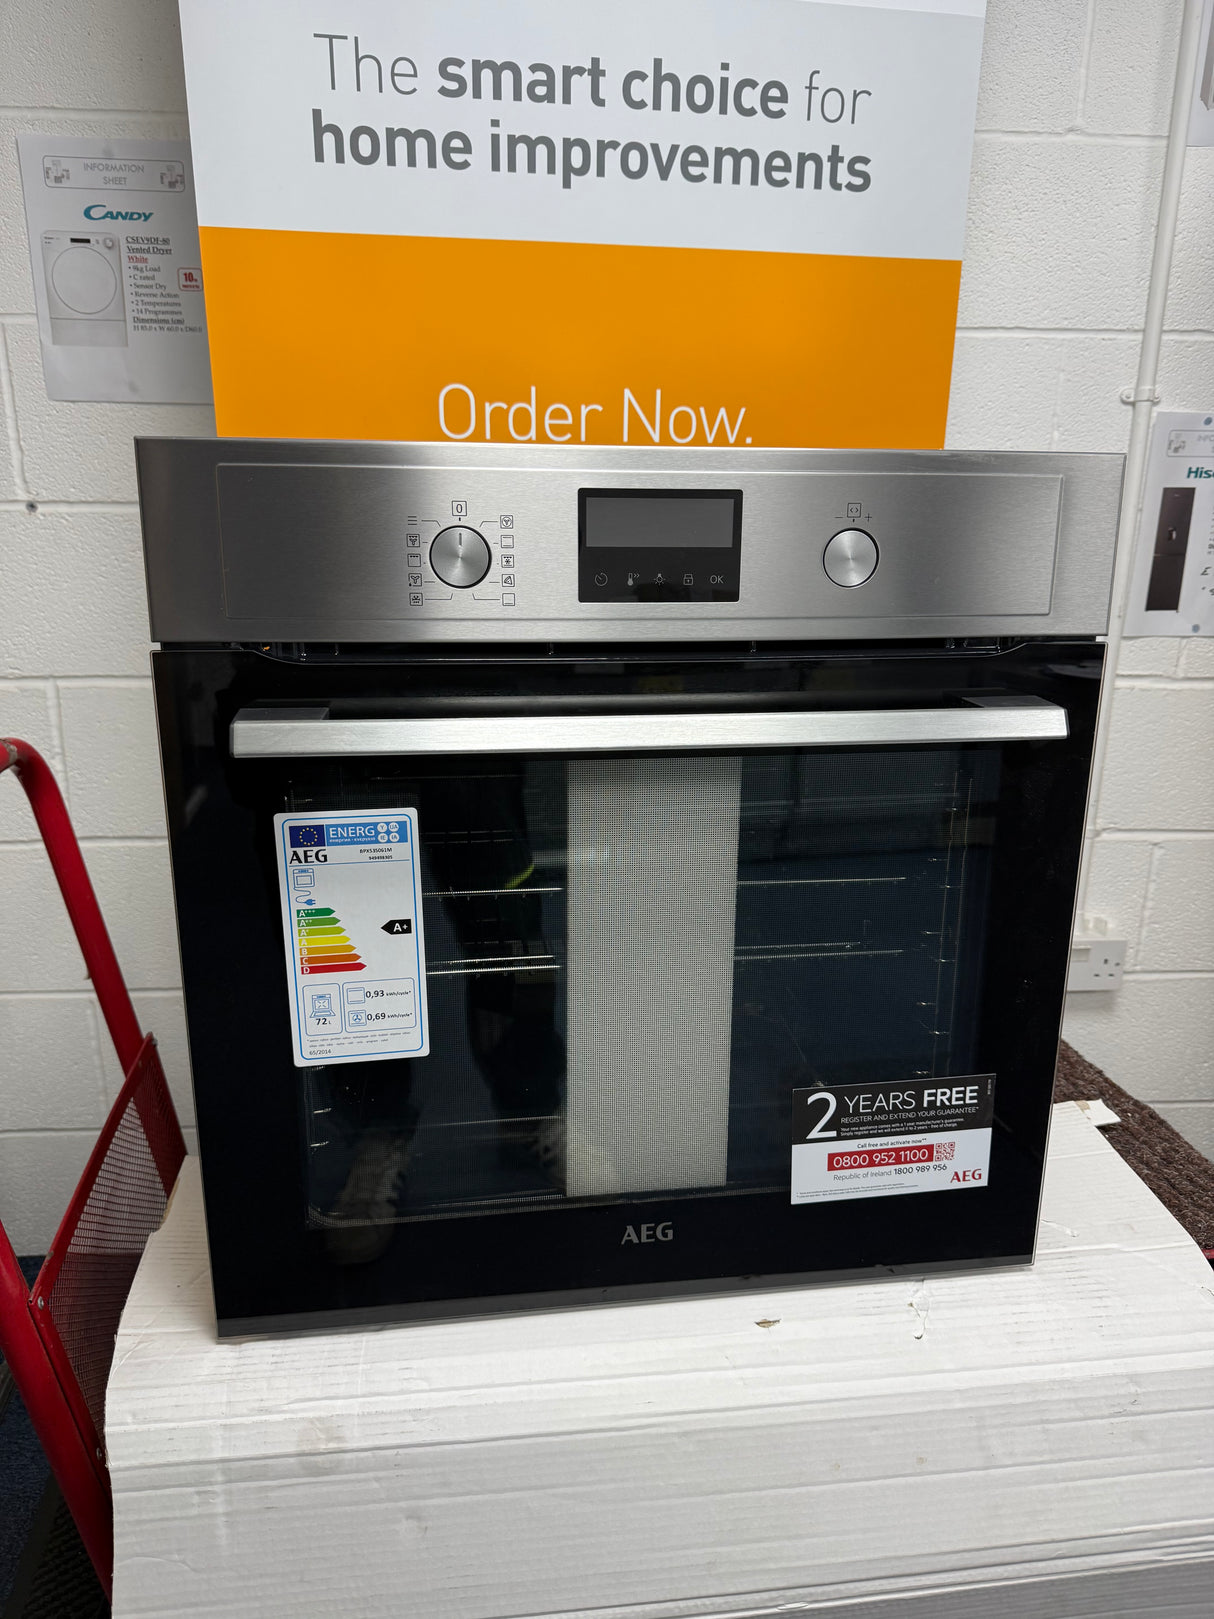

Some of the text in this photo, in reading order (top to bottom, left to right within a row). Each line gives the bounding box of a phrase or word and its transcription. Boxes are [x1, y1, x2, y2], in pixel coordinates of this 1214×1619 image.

[313, 33, 873, 124] The smart choice for
[312, 108, 872, 193] home improvements
[83, 162, 144, 173] INFORMATION
[103, 176, 127, 185] SHEET
[127, 246, 172, 255] Vented Dryer
[128, 255, 148, 264] White
[141, 300, 181, 308] Temperatures
[144, 308, 182, 316] Programmes
[133, 316, 170, 324] Dimensions
[438, 383, 752, 444] Order Now.
[1187, 467, 1214, 479] His
[710, 575, 724, 584] OK
[329, 826, 375, 838] ENERG
[289, 849, 328, 864] AEG
[393, 923, 408, 932] A+
[365, 990, 385, 999] 0,93
[367, 1013, 386, 1021] 0,69
[805, 1092, 837, 1139] 2
[844, 1091, 916, 1114] YEARS
[923, 1086, 979, 1108] FREE
[841, 1115, 873, 1124] REGISTER
[873, 1113, 888, 1121] AND
[889, 1111, 916, 1120] EXTEND
[833, 1148, 929, 1169] 0800 952 1100
[833, 1163, 948, 1181] Republic of Ireland 1800 989 956
[950, 1168, 982, 1183] AEG
[621, 1222, 674, 1245] AEG
